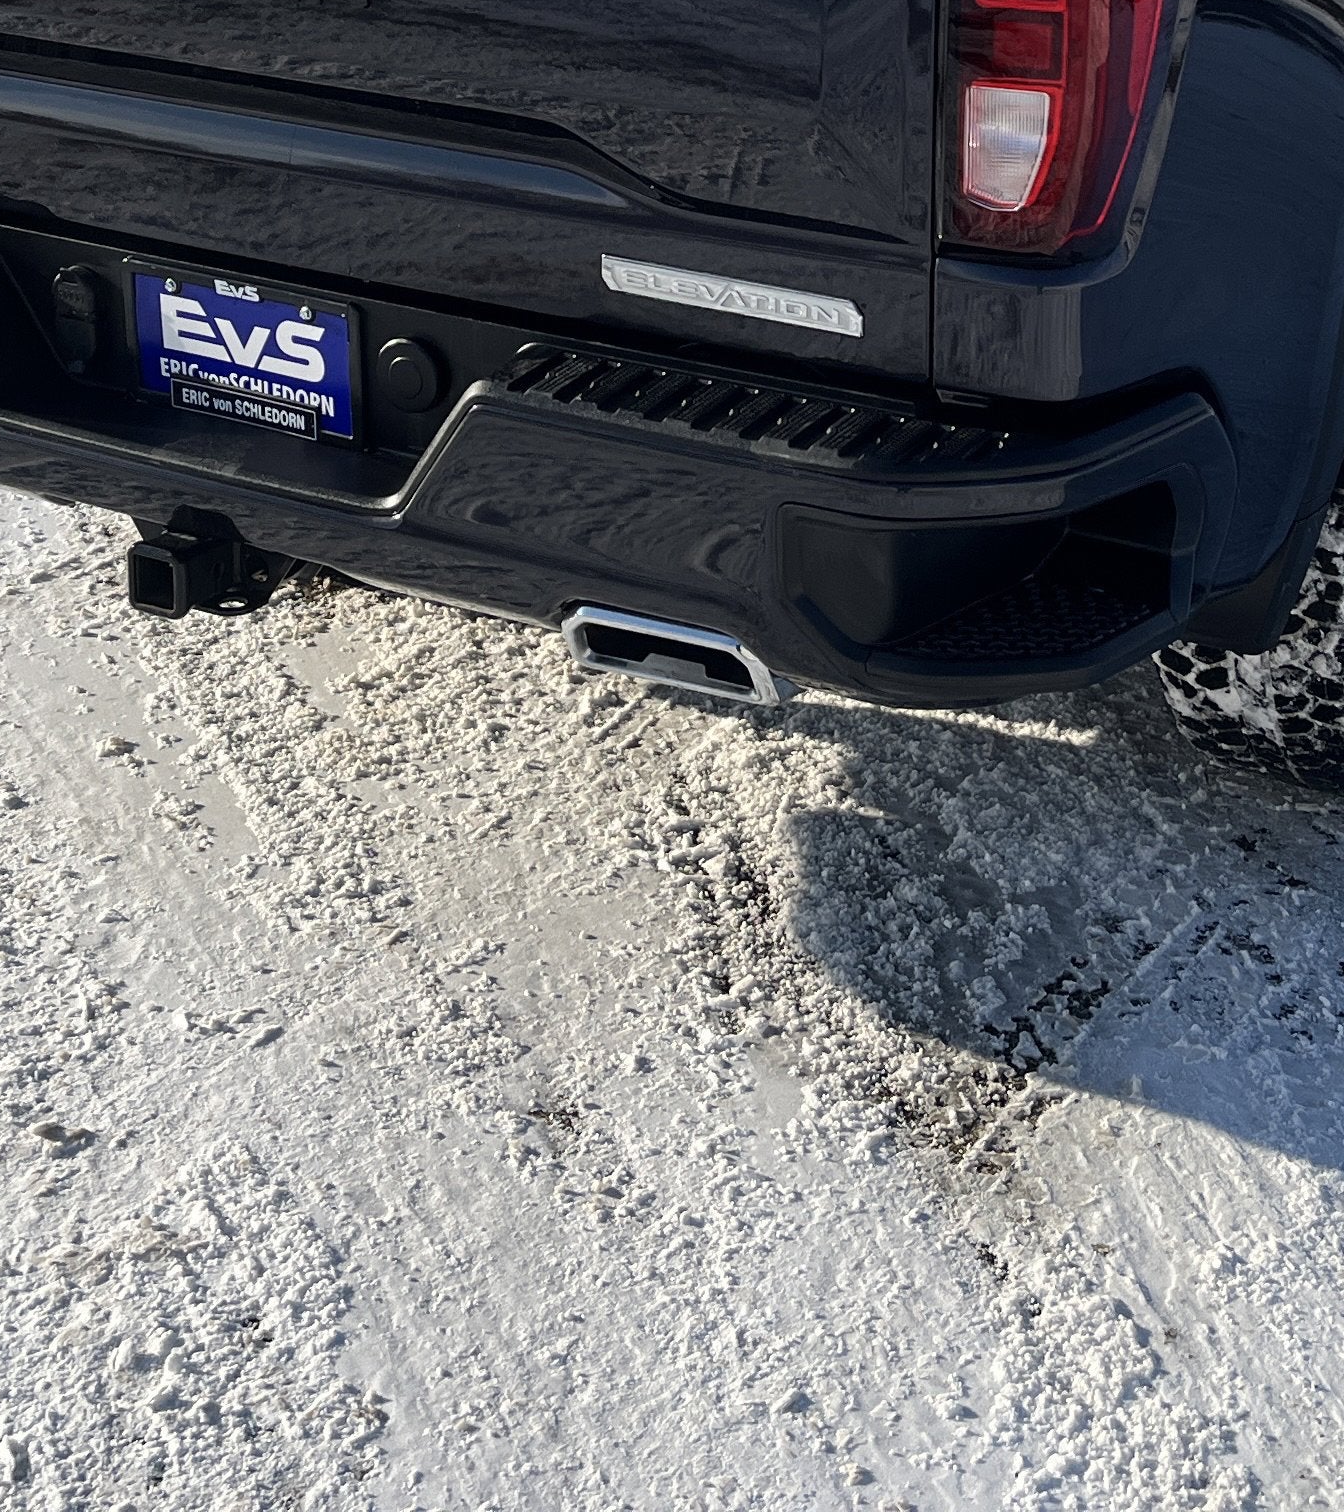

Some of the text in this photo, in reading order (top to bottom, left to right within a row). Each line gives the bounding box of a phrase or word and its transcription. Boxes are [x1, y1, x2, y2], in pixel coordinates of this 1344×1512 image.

[623, 269, 843, 328] ELEVATION
[182, 387, 305, 431] ERIC von SCHLEDORN
